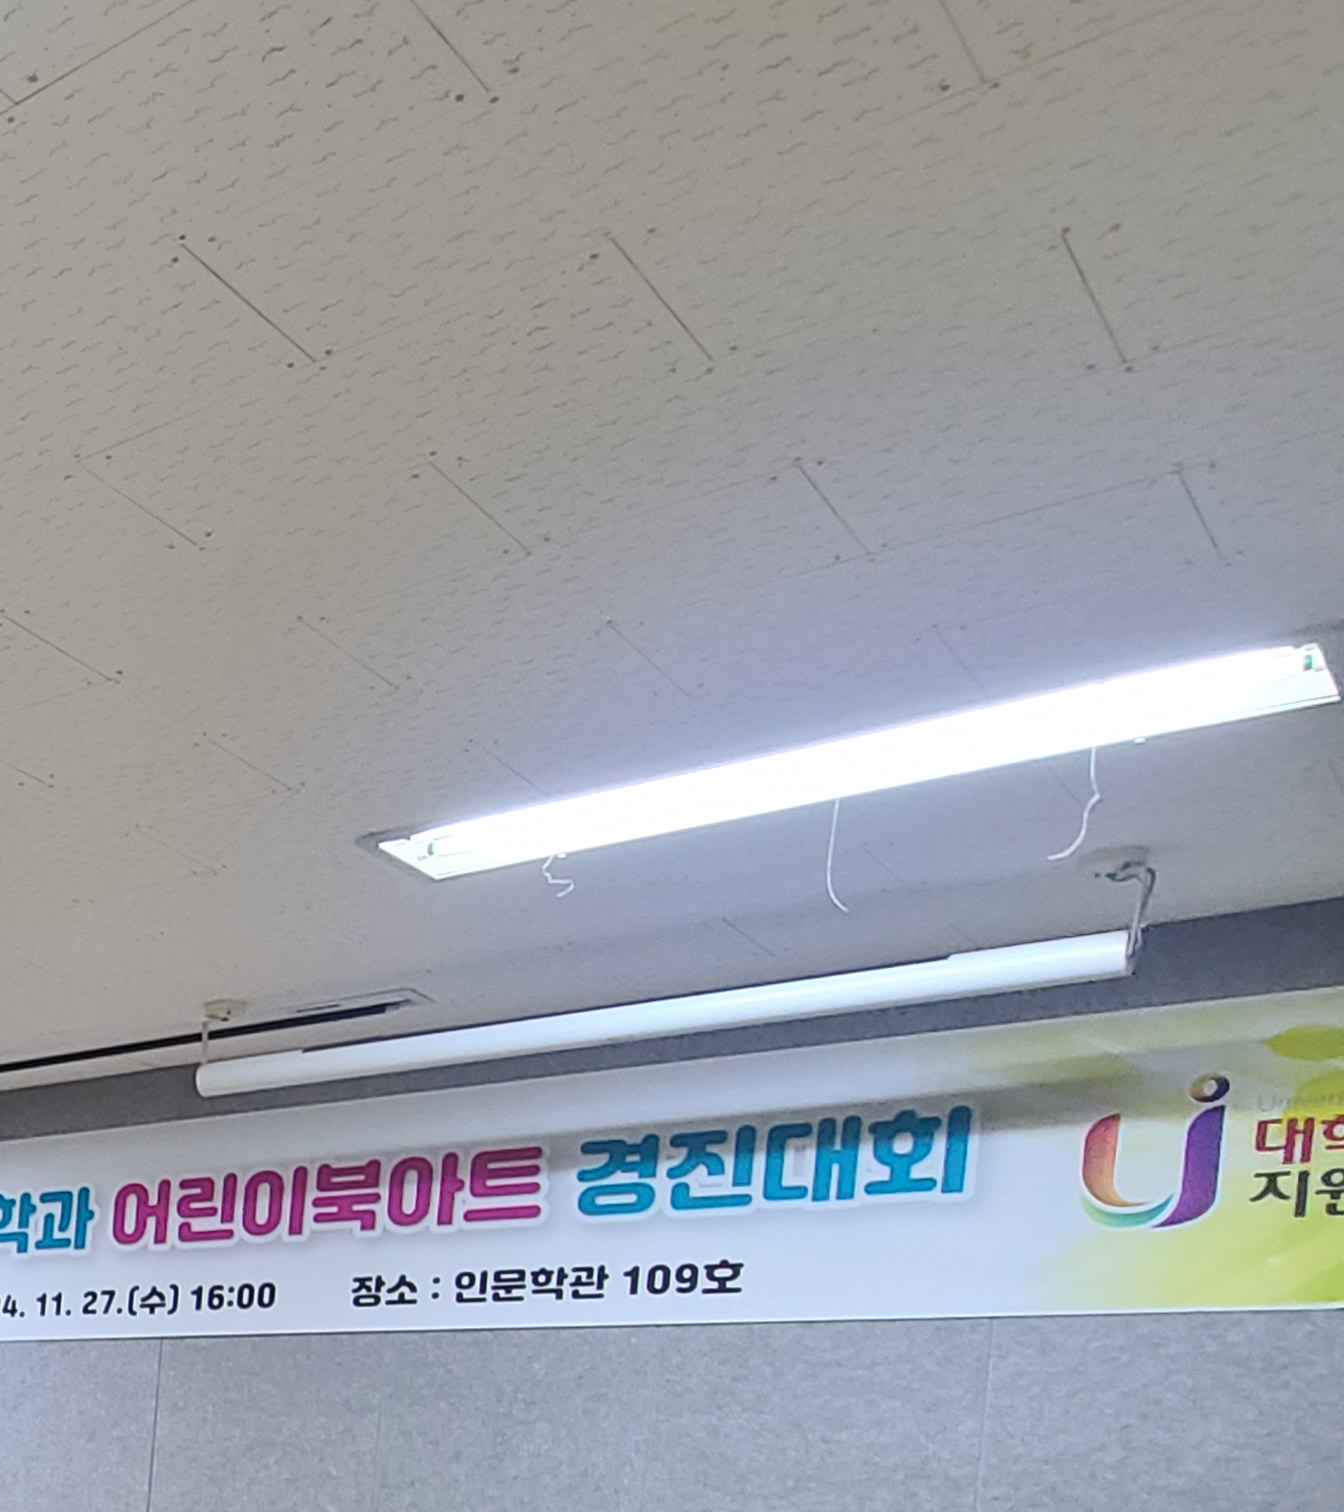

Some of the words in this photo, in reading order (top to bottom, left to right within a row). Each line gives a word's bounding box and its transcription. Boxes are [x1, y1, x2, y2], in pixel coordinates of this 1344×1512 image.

[112, 1146, 542, 1245] 어린이북아트
[576, 1105, 972, 1216] 경진대회
[36, 1292, 72, 1317] 11.
[190, 1282, 277, 1311] 16:00
[351, 1275, 418, 1307] 장소
[454, 1264, 610, 1304] 인문학관
[622, 1259, 744, 1296] 109호
